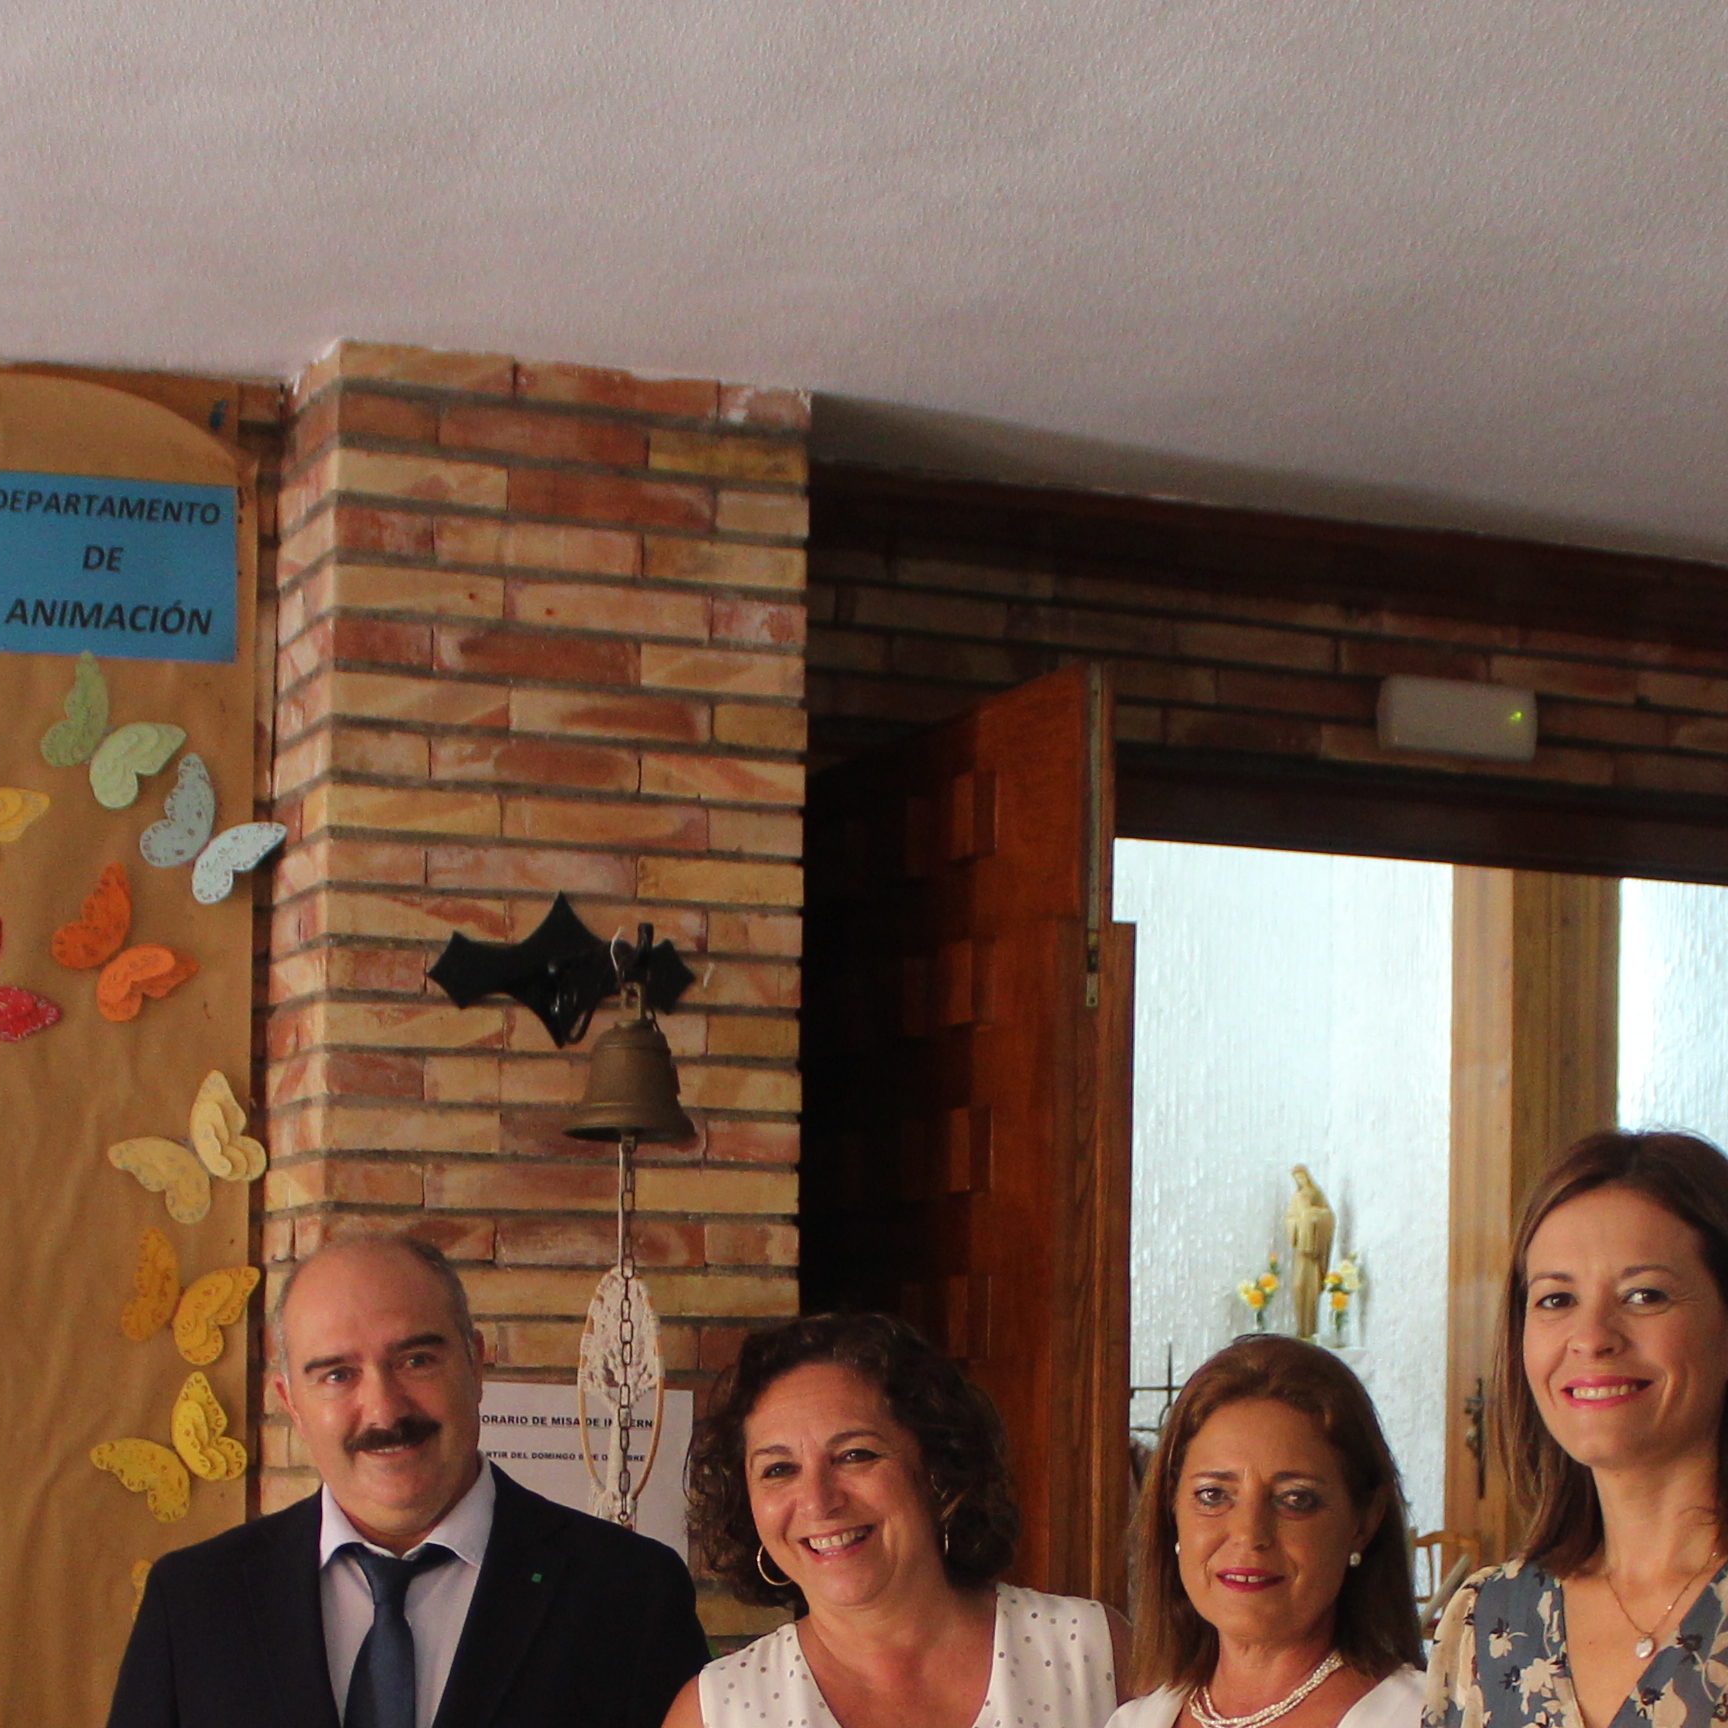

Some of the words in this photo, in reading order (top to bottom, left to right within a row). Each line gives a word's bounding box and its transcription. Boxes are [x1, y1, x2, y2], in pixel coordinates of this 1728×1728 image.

[82, 545, 125, 573] DE
[4, 597, 213, 637] ANIMACIÓN
[481, 1415, 528, 1425] ORARIO
[532, 1416, 547, 1425] DE
[551, 1416, 580, 1426] MISA
[511, 1451, 528, 1459] DEL
[531, 1452, 576, 1460] DOMINGO
